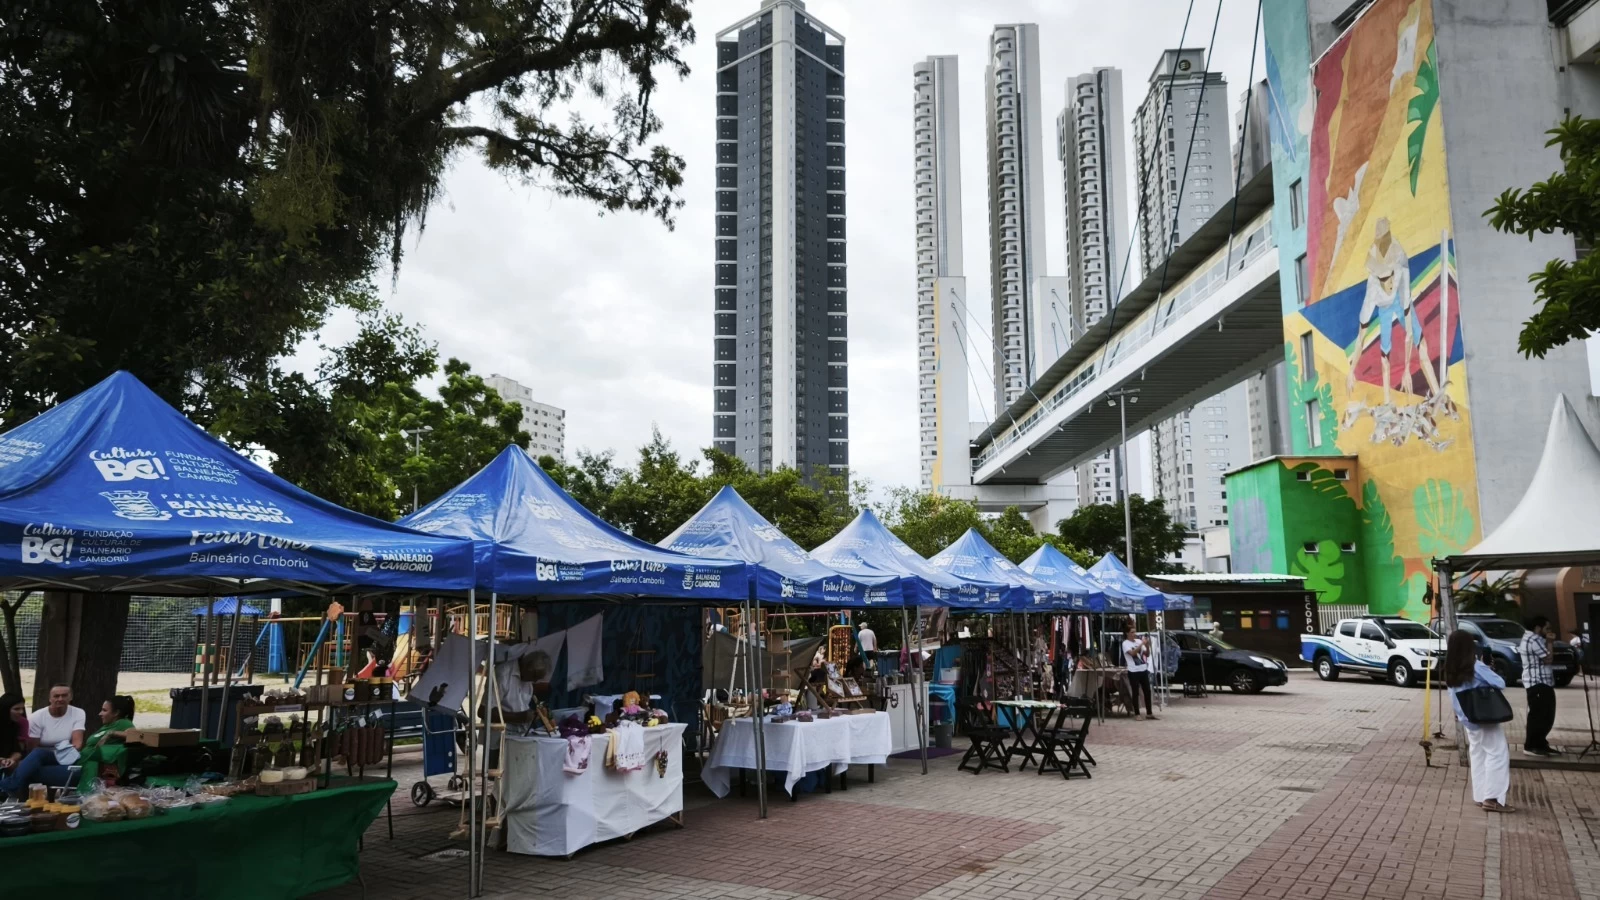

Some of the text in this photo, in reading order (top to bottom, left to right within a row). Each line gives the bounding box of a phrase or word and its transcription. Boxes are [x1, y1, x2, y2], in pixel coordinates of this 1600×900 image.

[89, 447, 157, 460] Cultura
[165, 451, 225, 467] FUNDAÇÃO
[169, 458, 226, 472] CULTURAL
[178, 472, 238, 485] CAMBORIÚ
[161, 493, 276, 507] PREFEITURA
[23, 522, 77, 536] Cultura
[83, 530, 134, 539] FUNDAÇÃO
[189, 530, 256, 546] Feiras
[79, 555, 129, 563] CAMBORIÚ
[189, 552, 309, 568] Balneário Camboriú
[1304, 595, 1314, 635] ECOPO
